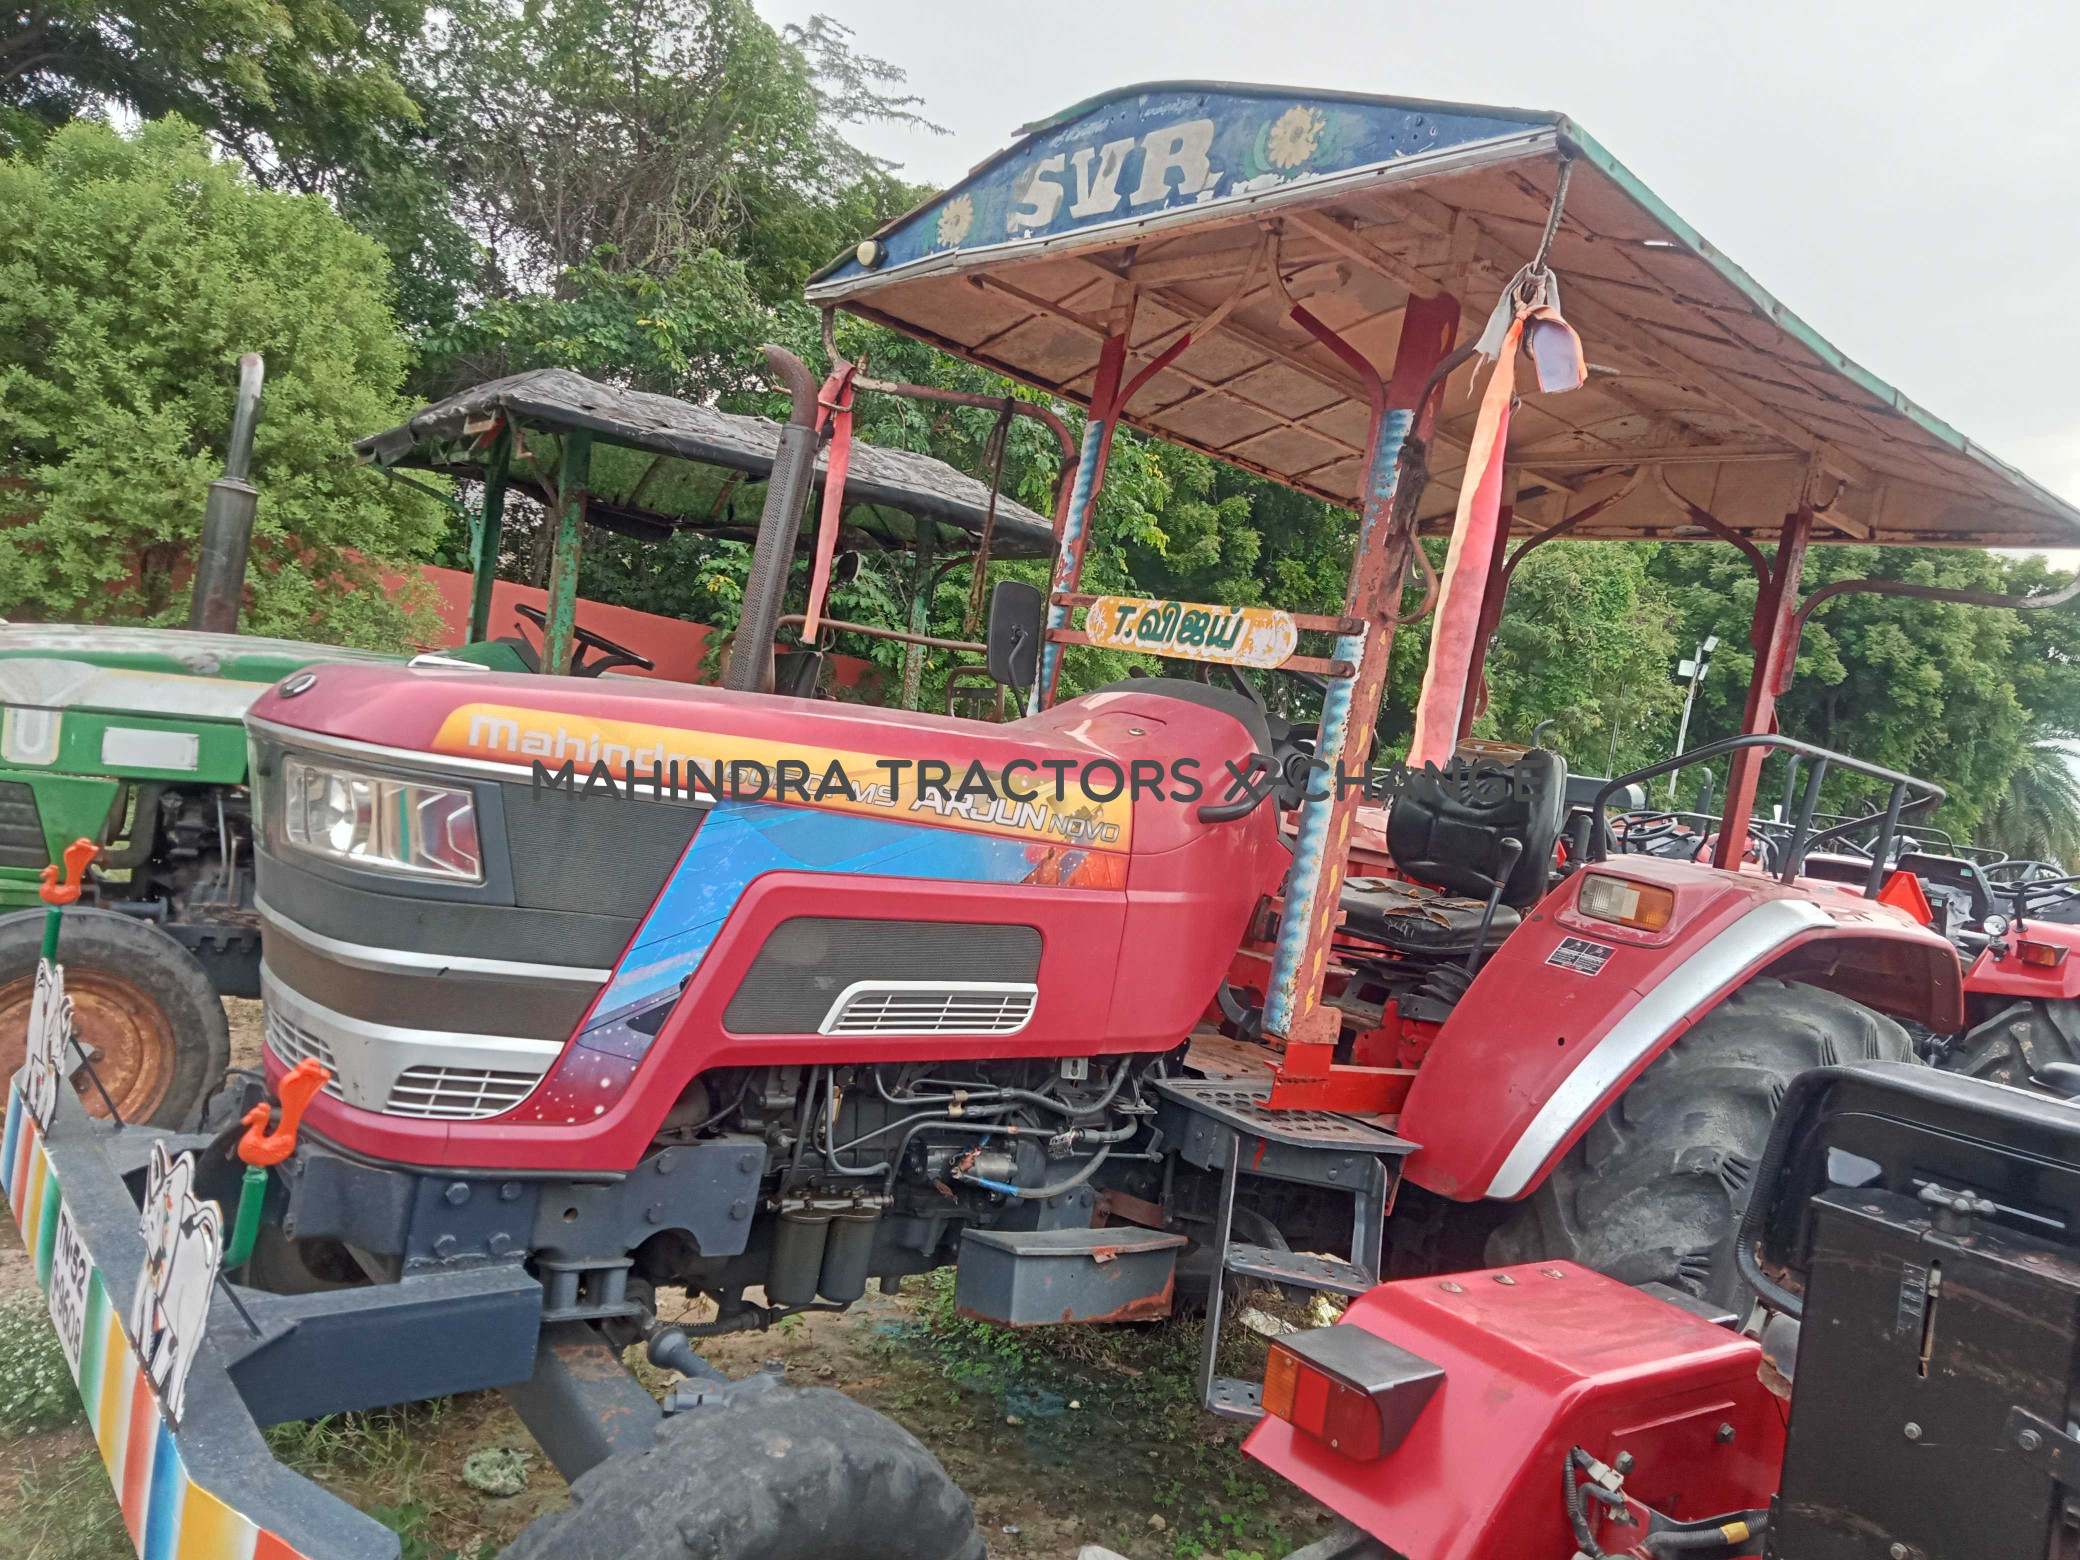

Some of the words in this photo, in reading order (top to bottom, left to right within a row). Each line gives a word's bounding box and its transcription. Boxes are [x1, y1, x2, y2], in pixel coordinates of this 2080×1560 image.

[1007, 119, 1224, 232] SVR
[908, 786, 1046, 830] ARJUN
[1049, 813, 1119, 843] NOVO
